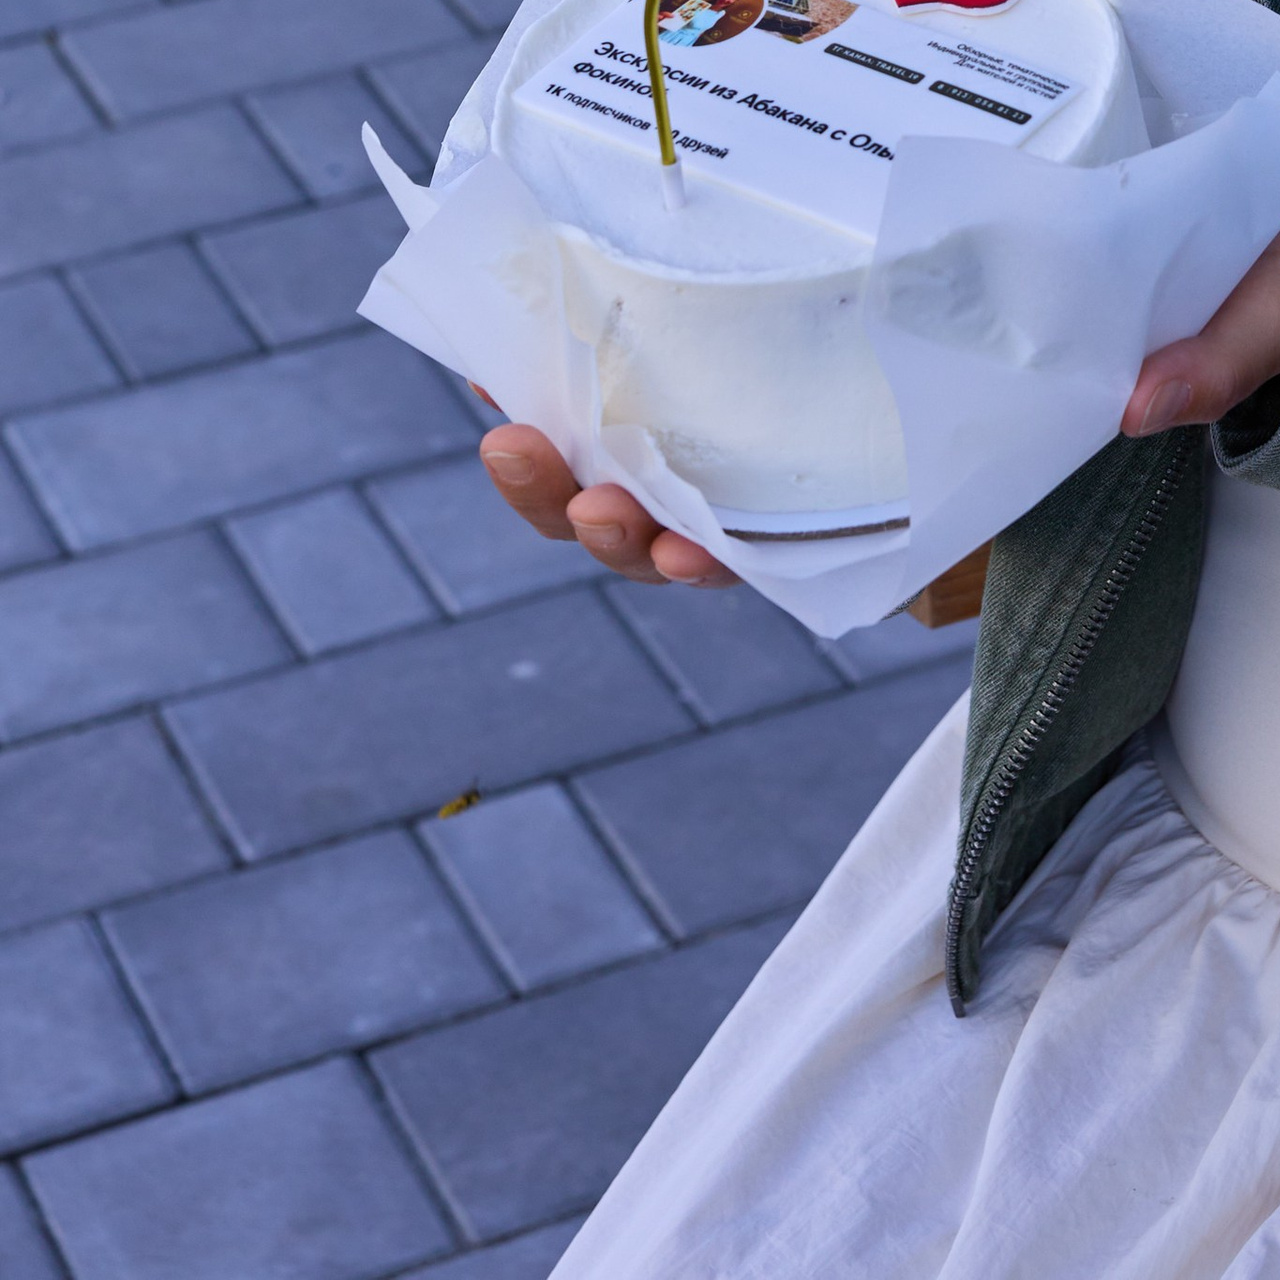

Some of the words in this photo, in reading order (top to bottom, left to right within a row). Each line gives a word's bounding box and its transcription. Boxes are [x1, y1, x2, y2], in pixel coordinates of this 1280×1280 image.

[573, 61, 669, 98] Фокино
[563, 91, 651, 130] подписчиков
[675, 135, 730, 160] друзей
[709, 83, 739, 100] из
[737, 93, 829, 135] Абакана
[830, 129, 847, 141] с
